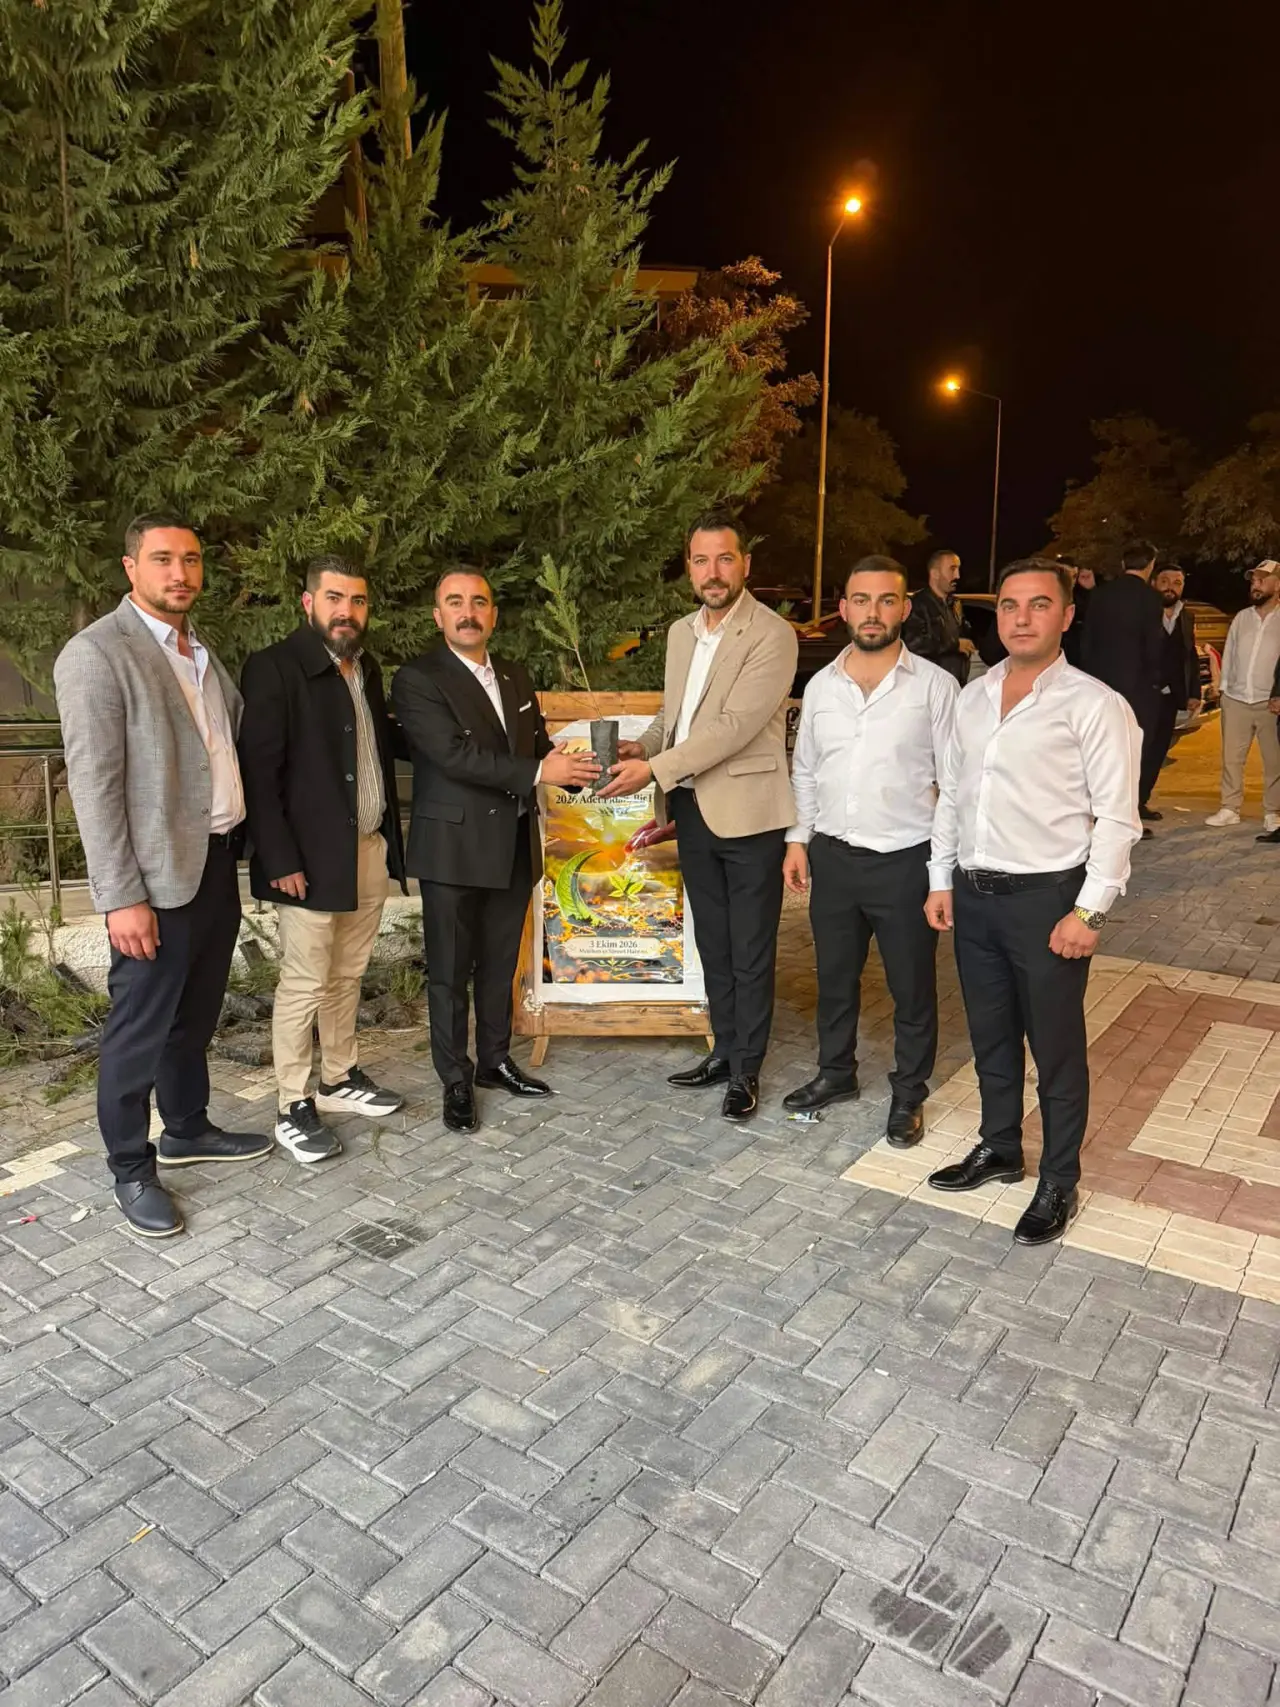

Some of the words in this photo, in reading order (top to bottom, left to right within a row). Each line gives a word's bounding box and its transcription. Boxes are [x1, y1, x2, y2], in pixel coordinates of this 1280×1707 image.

[589, 940, 594, 948] 3
[596, 940, 617, 948] Ekim
[619, 940, 638, 948] 2026
